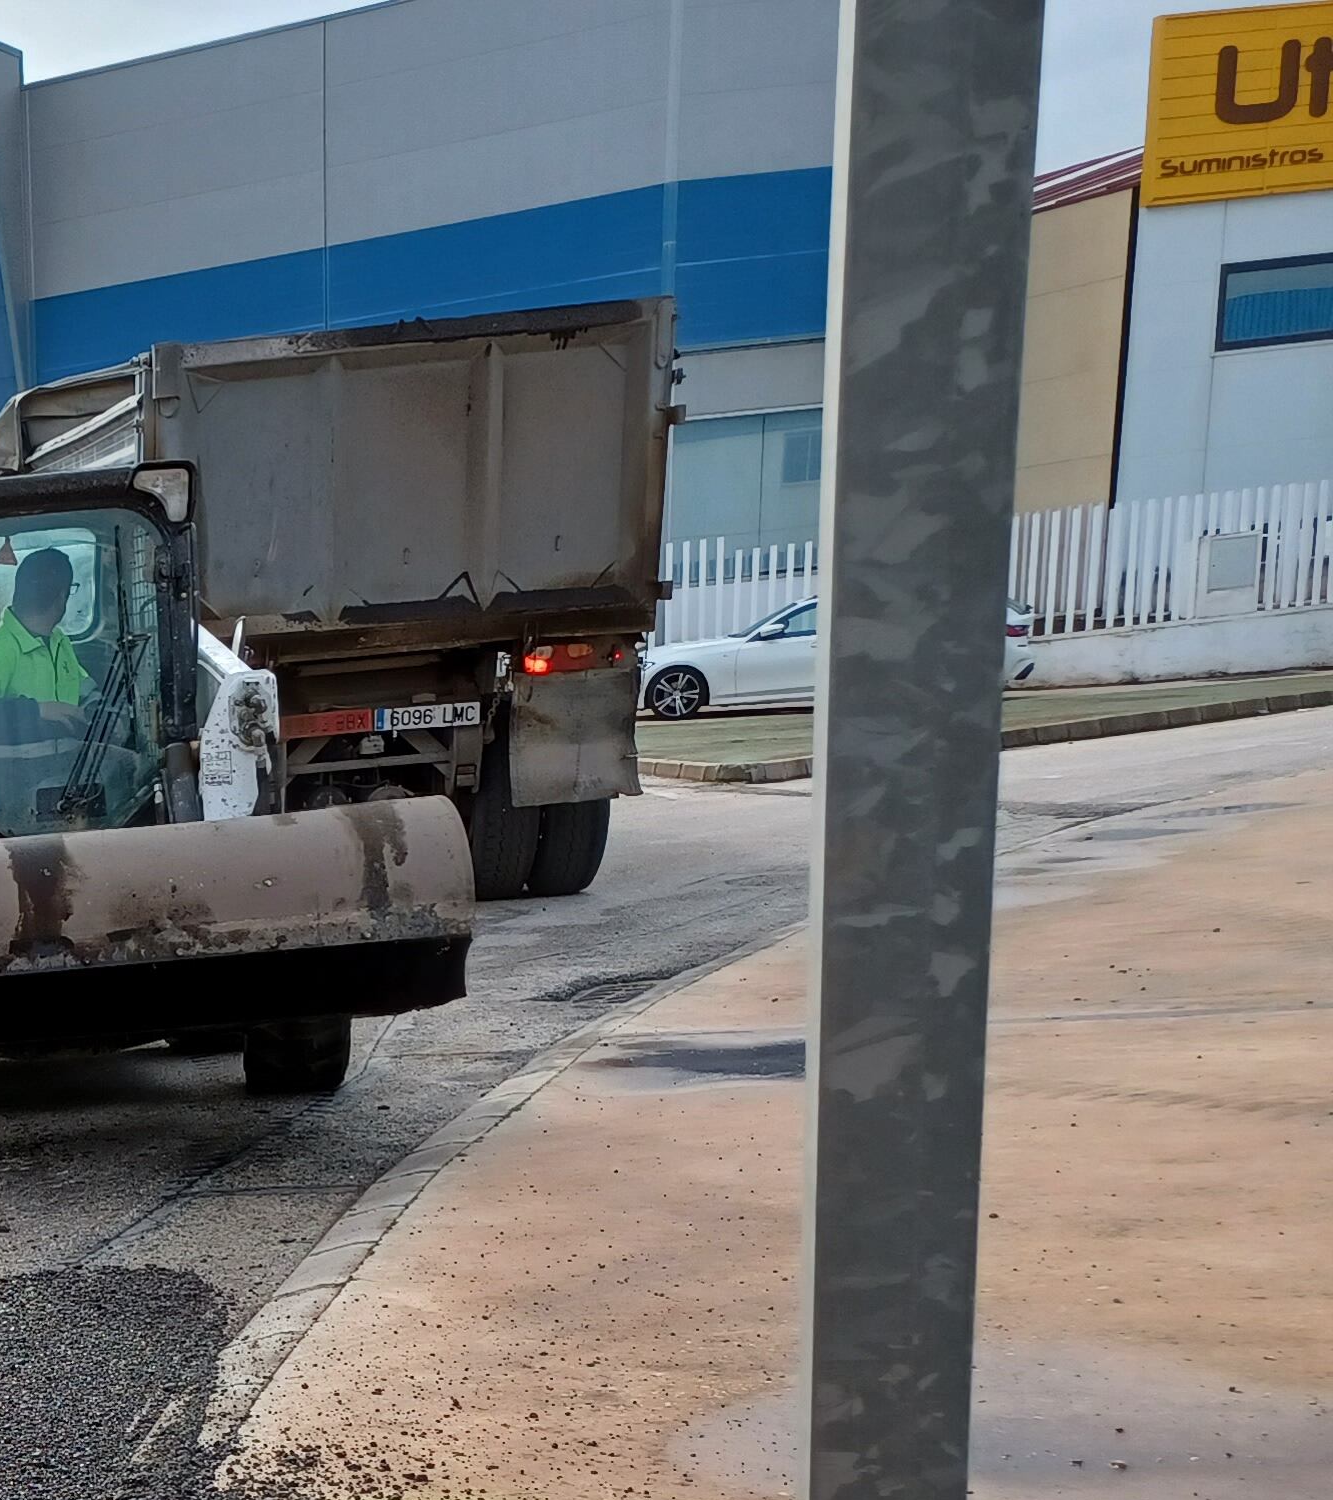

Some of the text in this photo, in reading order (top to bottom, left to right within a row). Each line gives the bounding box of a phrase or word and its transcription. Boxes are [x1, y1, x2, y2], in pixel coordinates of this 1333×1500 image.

[1160, 147, 1324, 178] Suministros
[390, 705, 476, 727] 6096 LMC
